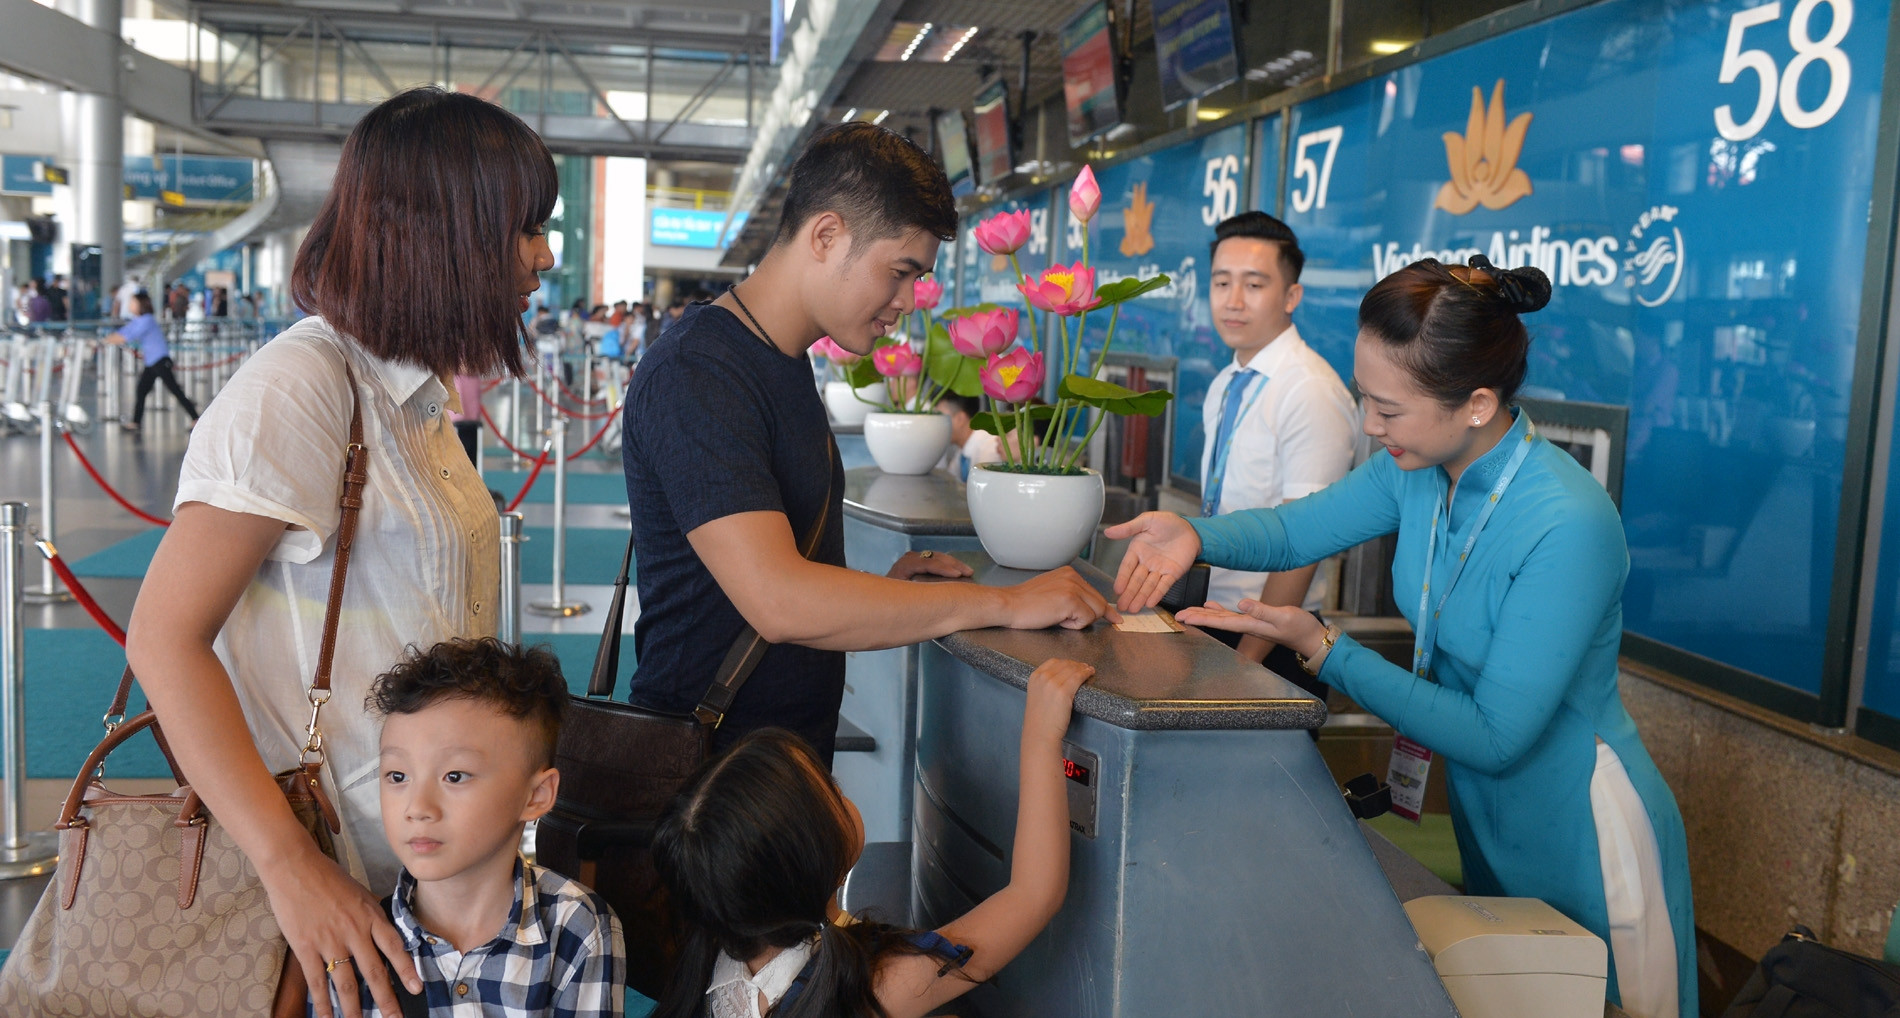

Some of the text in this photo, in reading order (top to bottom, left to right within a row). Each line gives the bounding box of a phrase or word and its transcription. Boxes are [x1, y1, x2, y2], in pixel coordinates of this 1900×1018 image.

[1713, 0, 1853, 142] 58
[1202, 154, 1239, 227] 56
[1291, 125, 1344, 214] 57
[1372, 225, 1619, 287] Vietam Airlines
